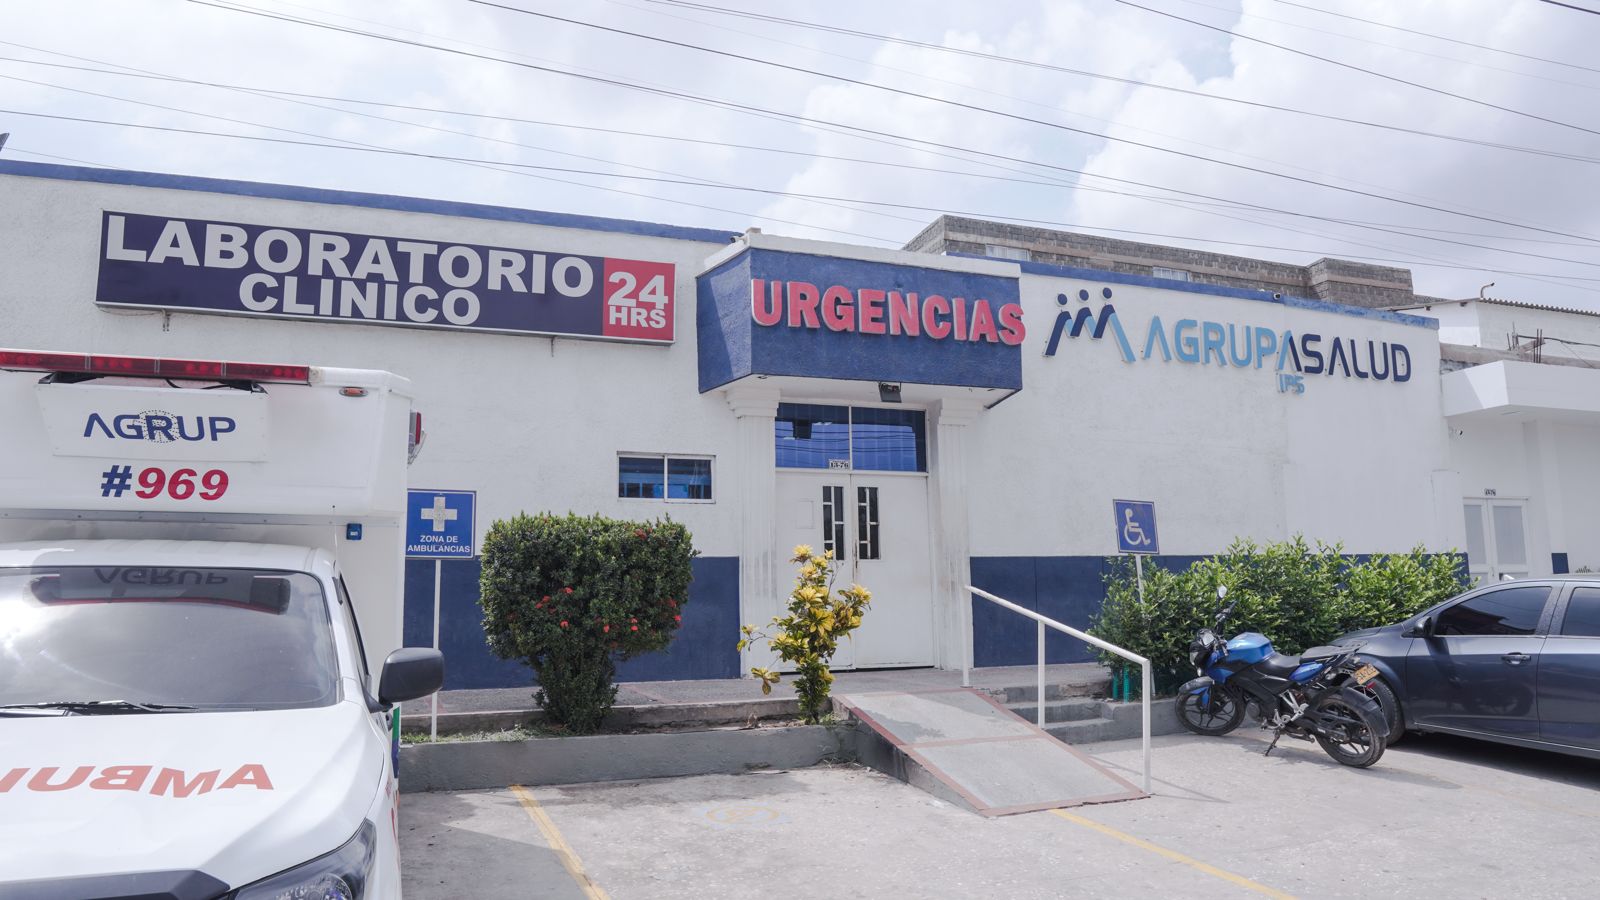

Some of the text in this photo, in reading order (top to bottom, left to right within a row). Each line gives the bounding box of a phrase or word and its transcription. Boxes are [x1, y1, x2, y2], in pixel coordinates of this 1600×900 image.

[106, 215, 594, 298] LABORATORIO
[239, 272, 481, 326] CLINICO
[608, 271, 669, 310] 24
[609, 305, 666, 329] HRS
[751, 278, 1026, 345] URGENCIAS
[1142, 315, 1412, 383] AGRUPASALUD
[1276, 373, 1305, 394] IPS
[83, 412, 236, 442] AGRUP
[100, 464, 229, 501] #969
[407, 544, 471, 553] AMBULANCIAS
[420, 535, 458, 543] ZONA DE
